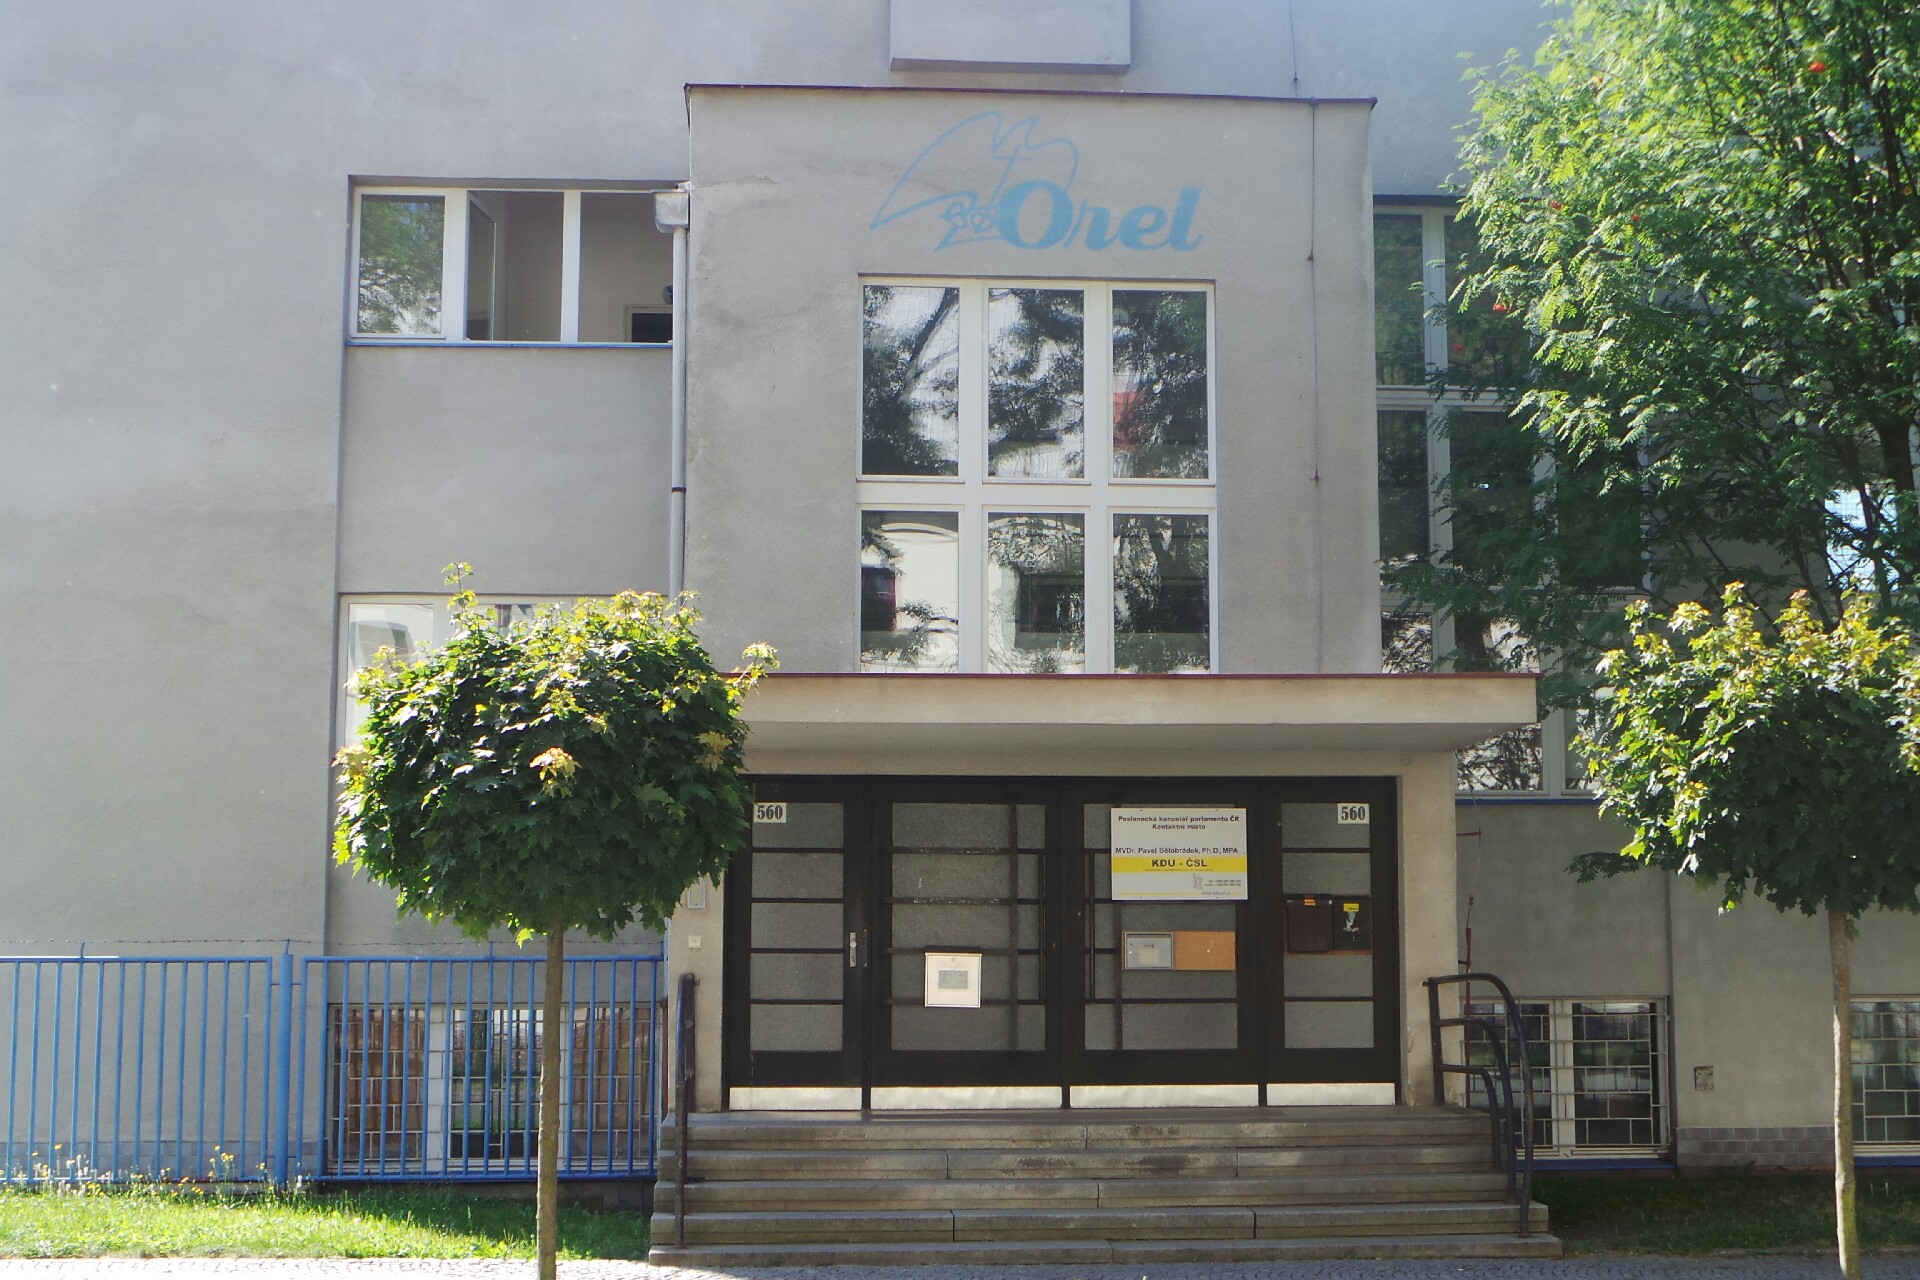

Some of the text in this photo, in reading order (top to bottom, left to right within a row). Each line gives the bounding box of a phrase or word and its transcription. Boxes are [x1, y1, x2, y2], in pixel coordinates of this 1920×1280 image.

[999, 180, 1203, 251] Orel
[757, 805, 783, 820] 560
[1341, 806, 1366, 821] 560
[1159, 847, 1201, 855] Bělobrádek,
[1151, 859, 1176, 867] KDU
[1186, 857, 1208, 867] ČSL
